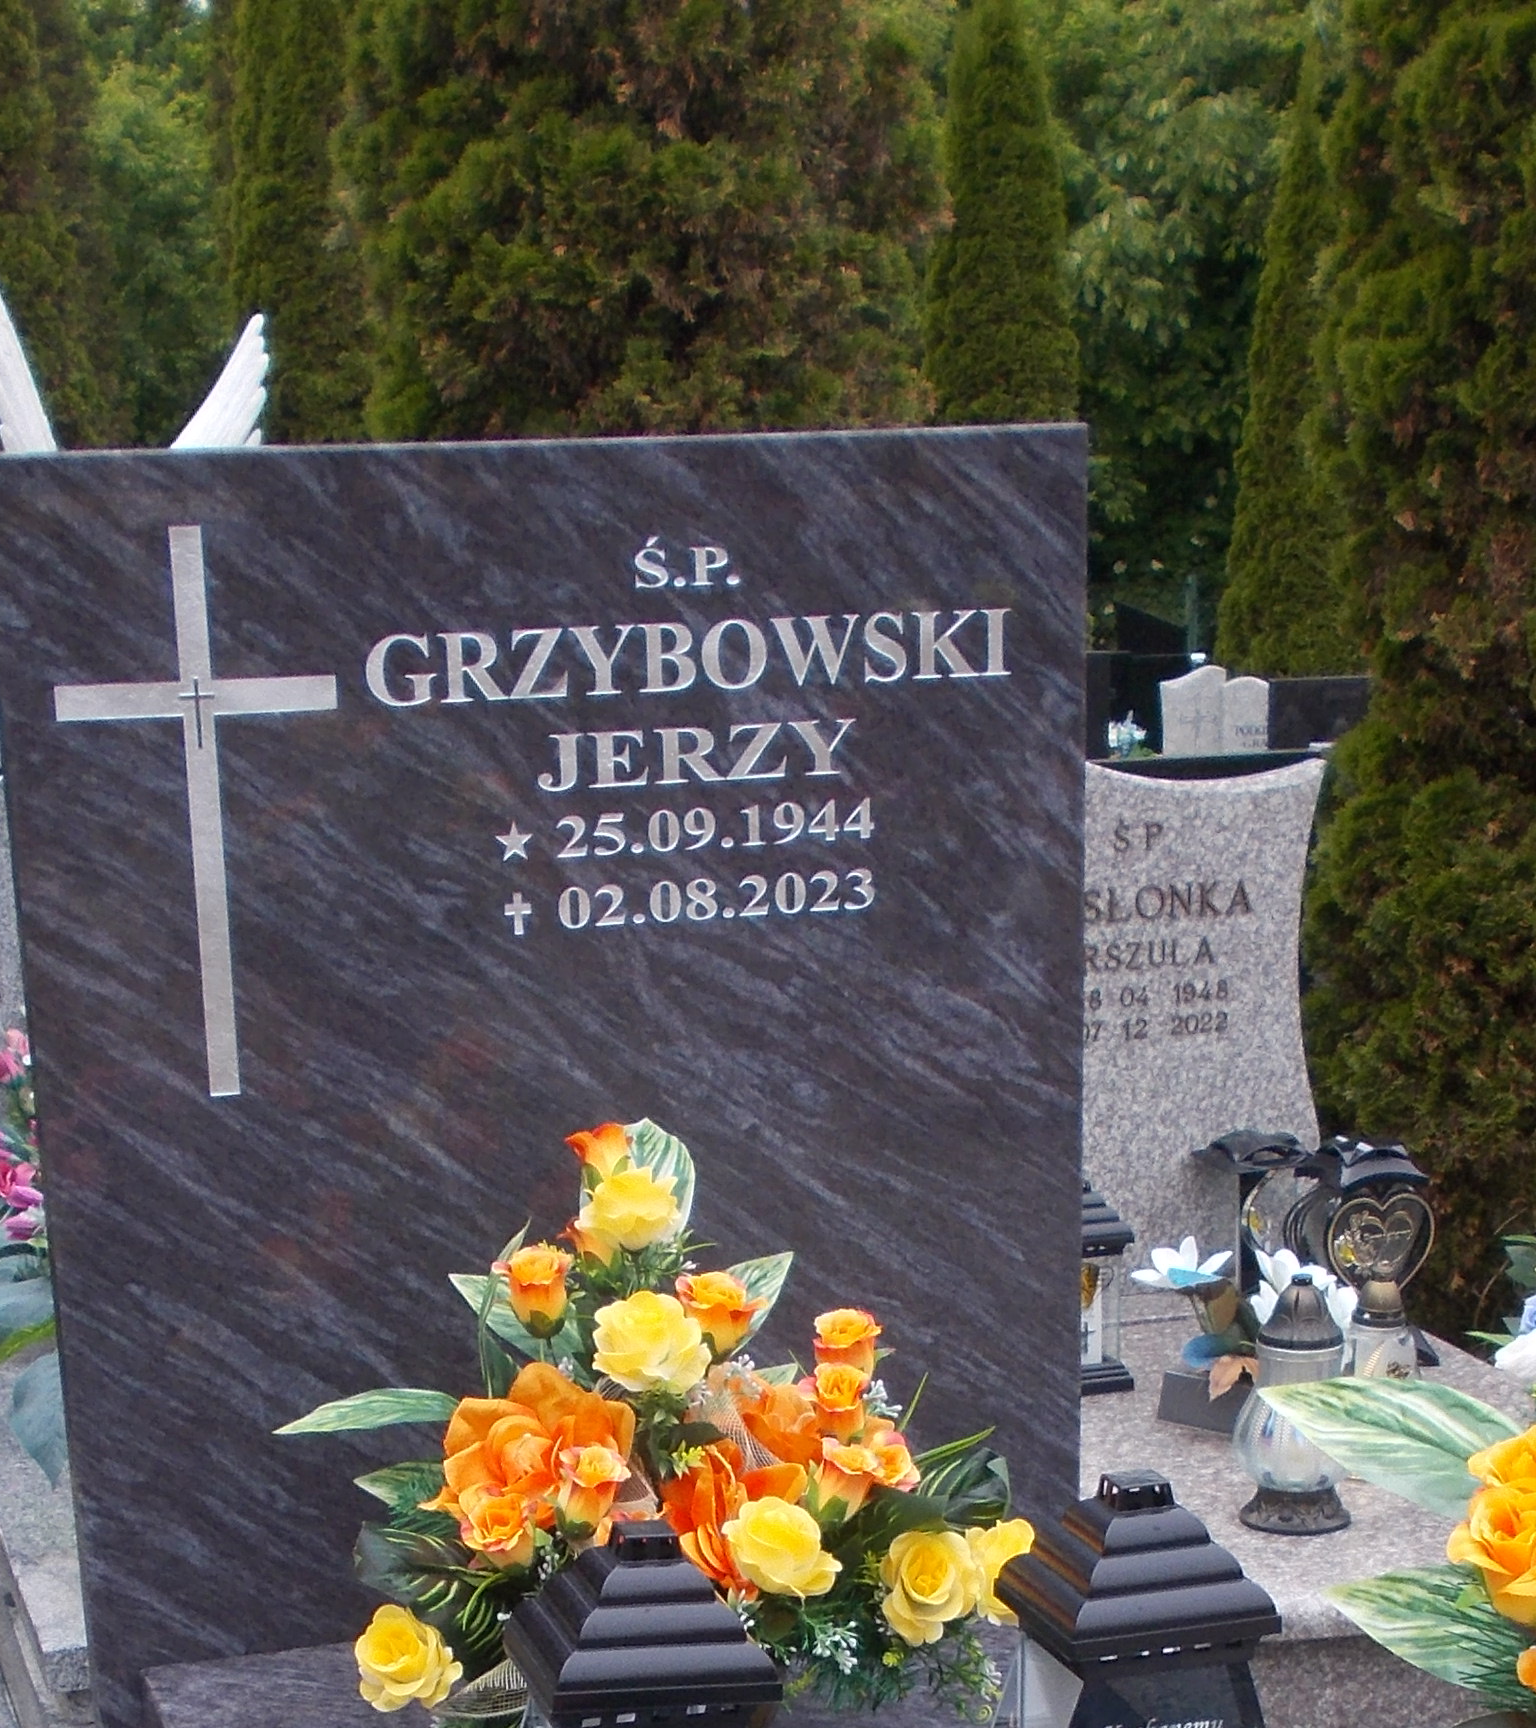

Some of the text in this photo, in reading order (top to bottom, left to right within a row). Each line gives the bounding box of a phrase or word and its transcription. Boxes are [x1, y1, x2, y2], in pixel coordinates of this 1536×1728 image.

[633, 536, 741, 589] Ś.P.
[364, 607, 1012, 707] GRZYBOWSKI
[536, 717, 857, 793] JERZY
[555, 797, 876, 860] 25.09.1944
[557, 868, 877, 930] 02.08.2023
